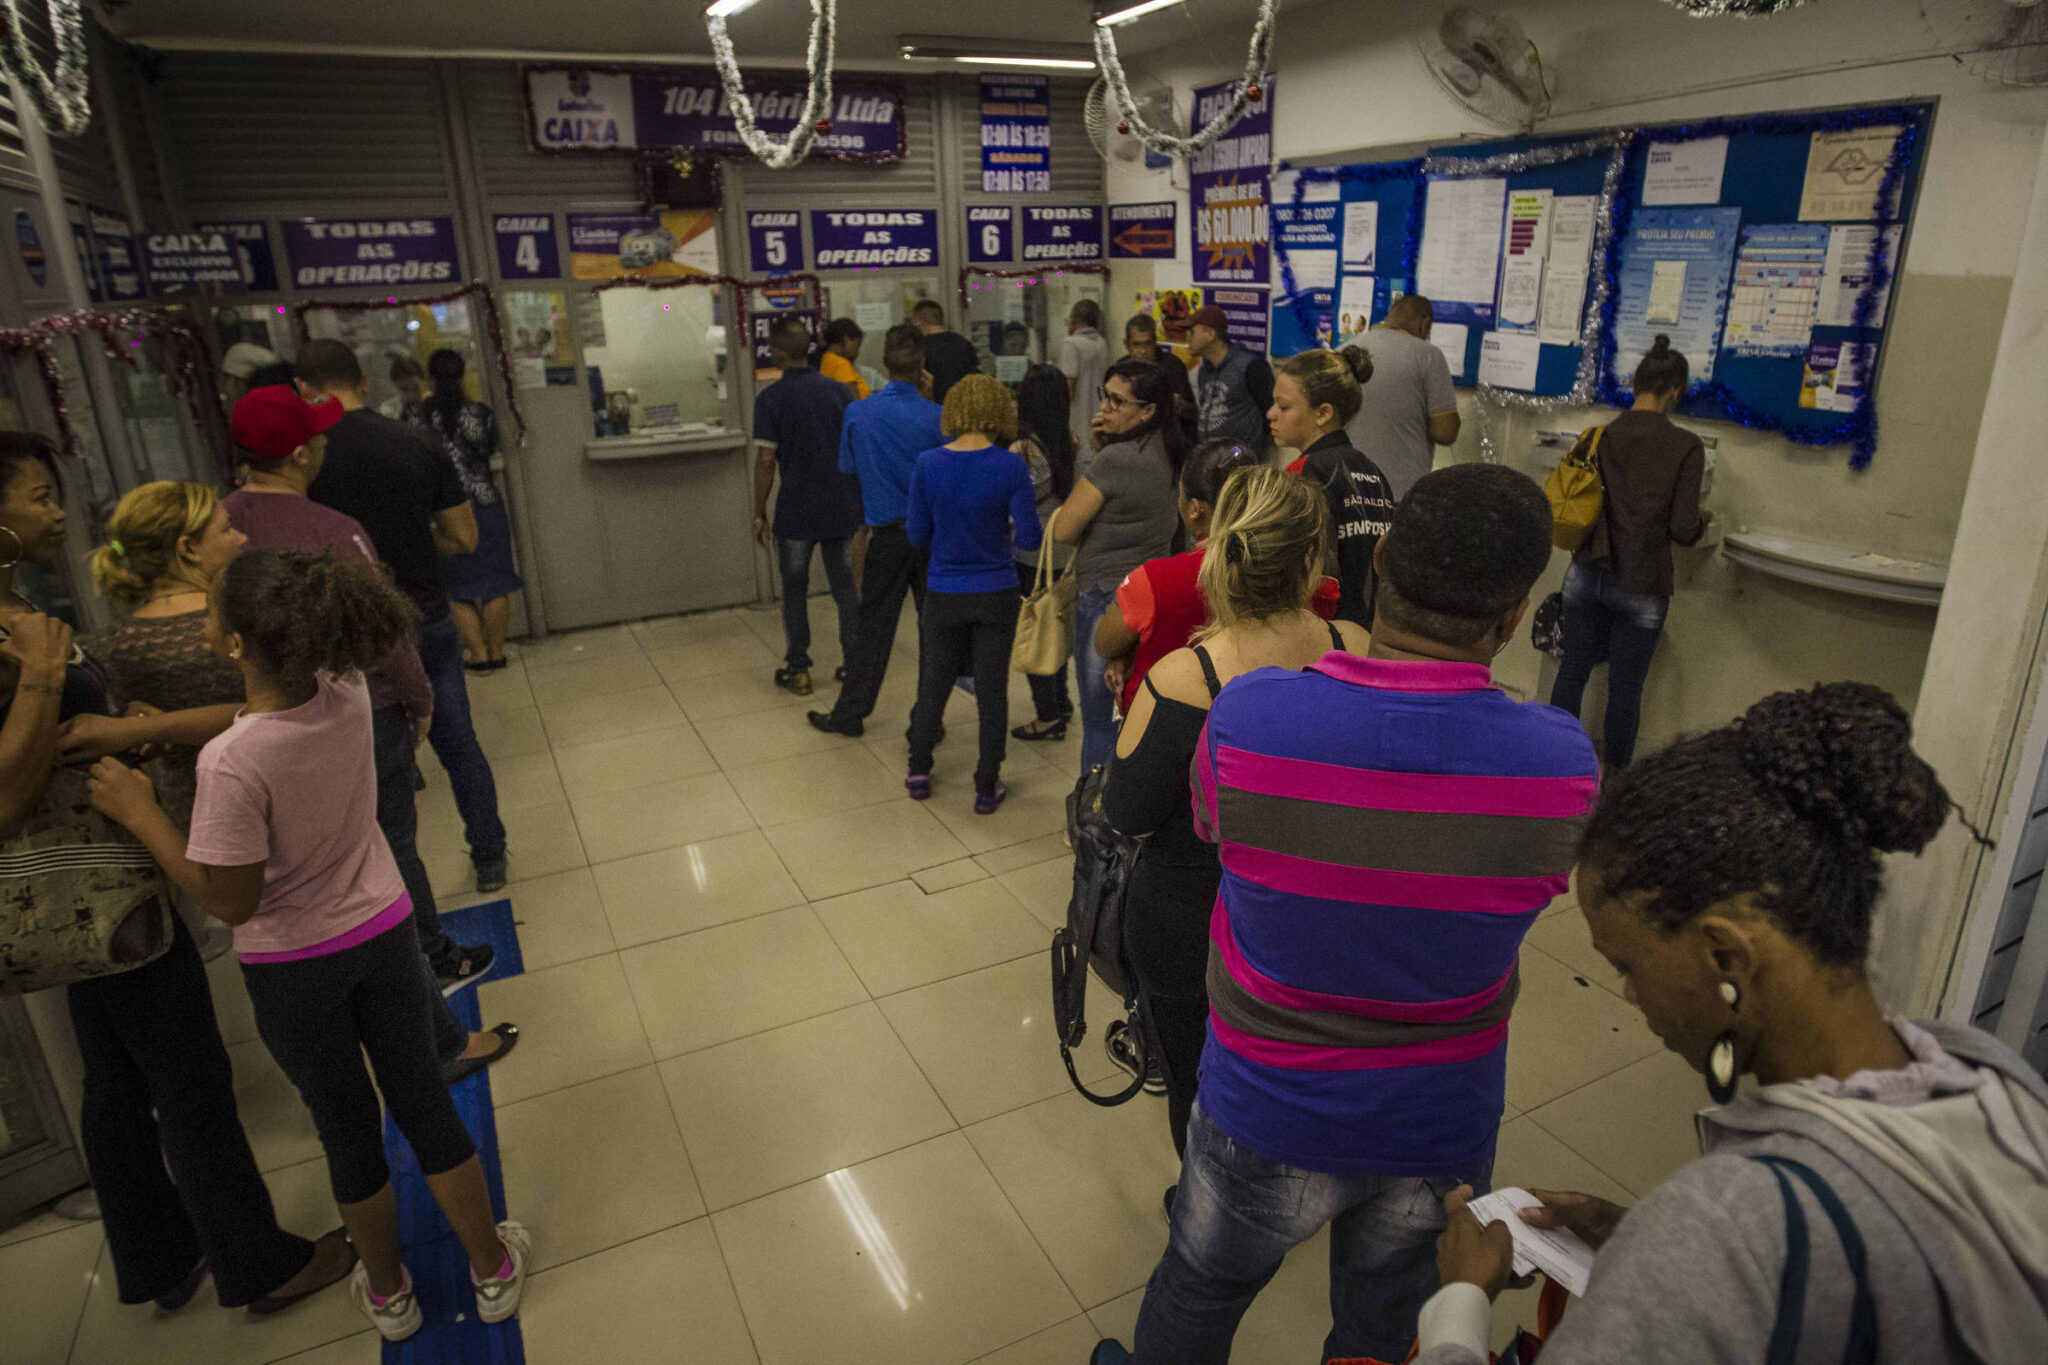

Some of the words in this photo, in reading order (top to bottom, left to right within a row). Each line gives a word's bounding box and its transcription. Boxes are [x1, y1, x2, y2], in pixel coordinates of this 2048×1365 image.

[663, 86, 715, 116] 104
[544, 117, 619, 142] CAIXA
[751, 213, 798, 227] CAIXA
[827, 213, 924, 226] TODAS
[969, 208, 1010, 221] CAIXA
[1030, 208, 1093, 220] TODAS
[1111, 204, 1174, 221] ATENDIMENTO
[304, 221, 436, 239] TODAS
[496, 217, 549, 232] CAIXA
[1051, 225, 1071, 238] AS
[148, 233, 228, 253] CAIXA
[863, 231, 891, 244] AS
[981, 224, 1001, 256] 6
[356, 243, 395, 259] AS
[515, 234, 540, 274] 4
[764, 231, 787, 266] 5
[817, 247, 932, 265] OPERAÇÕES
[1024, 241, 1100, 259] OPERAÇÕES
[296, 260, 451, 286] OPERAÇÕES
